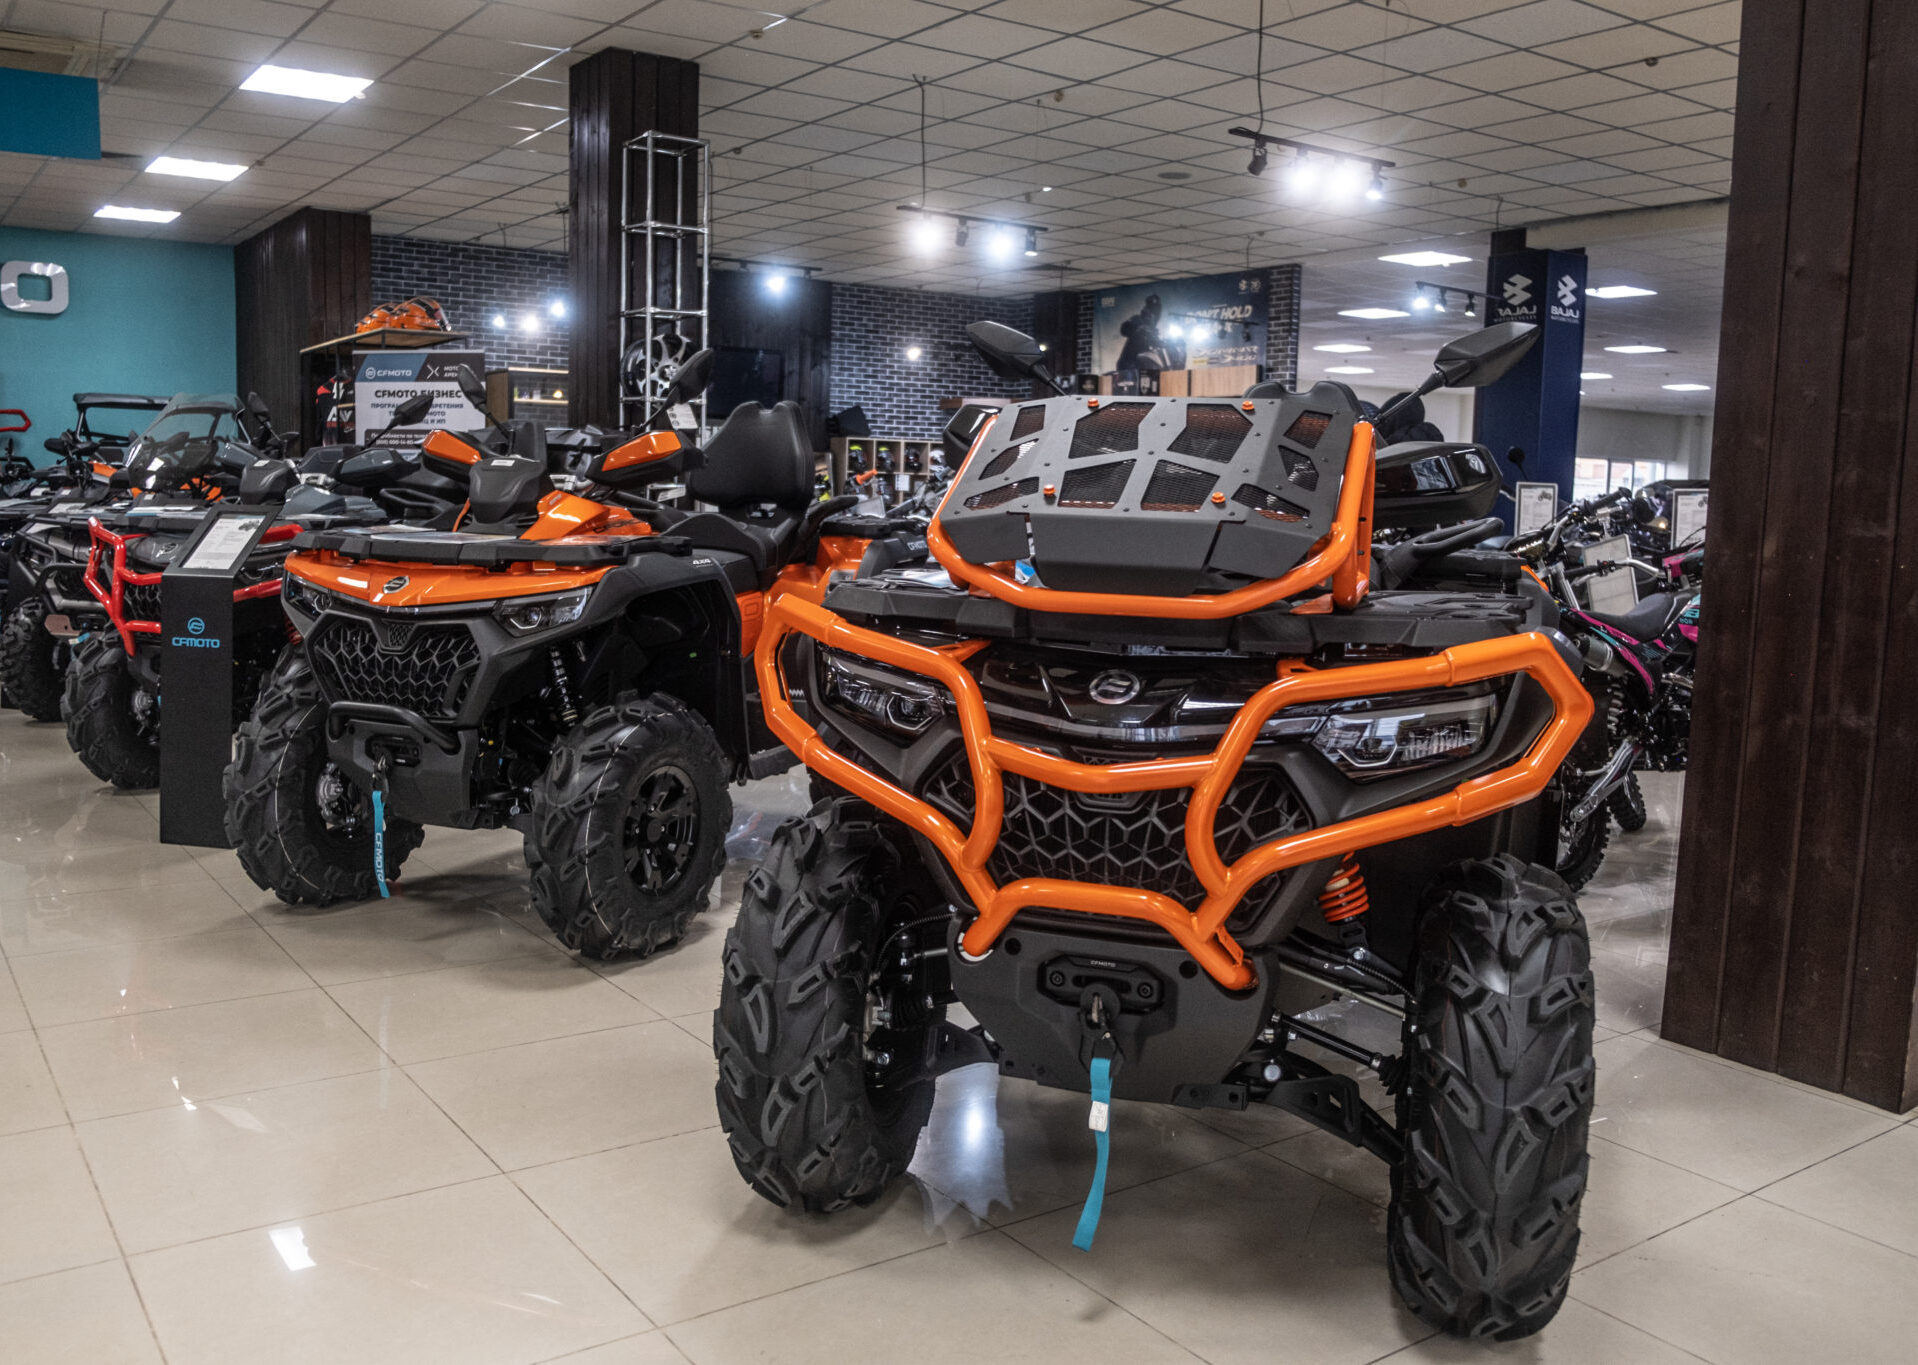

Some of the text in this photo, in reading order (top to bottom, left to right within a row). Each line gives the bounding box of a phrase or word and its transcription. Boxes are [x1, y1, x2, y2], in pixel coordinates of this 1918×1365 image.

[1, 261, 69, 314] O
[1220, 305, 1252, 320] HOLD
[1551, 305, 1579, 318] BAJAJ
[377, 369, 412, 377] CFMOTO
[375, 390, 462, 398] CFMOTO БИЗНЕС
[172, 637, 220, 648] CFMOTO
[375, 832, 384, 882] CFMOTO
[1090, 960, 1116, 968] CFMOTO
